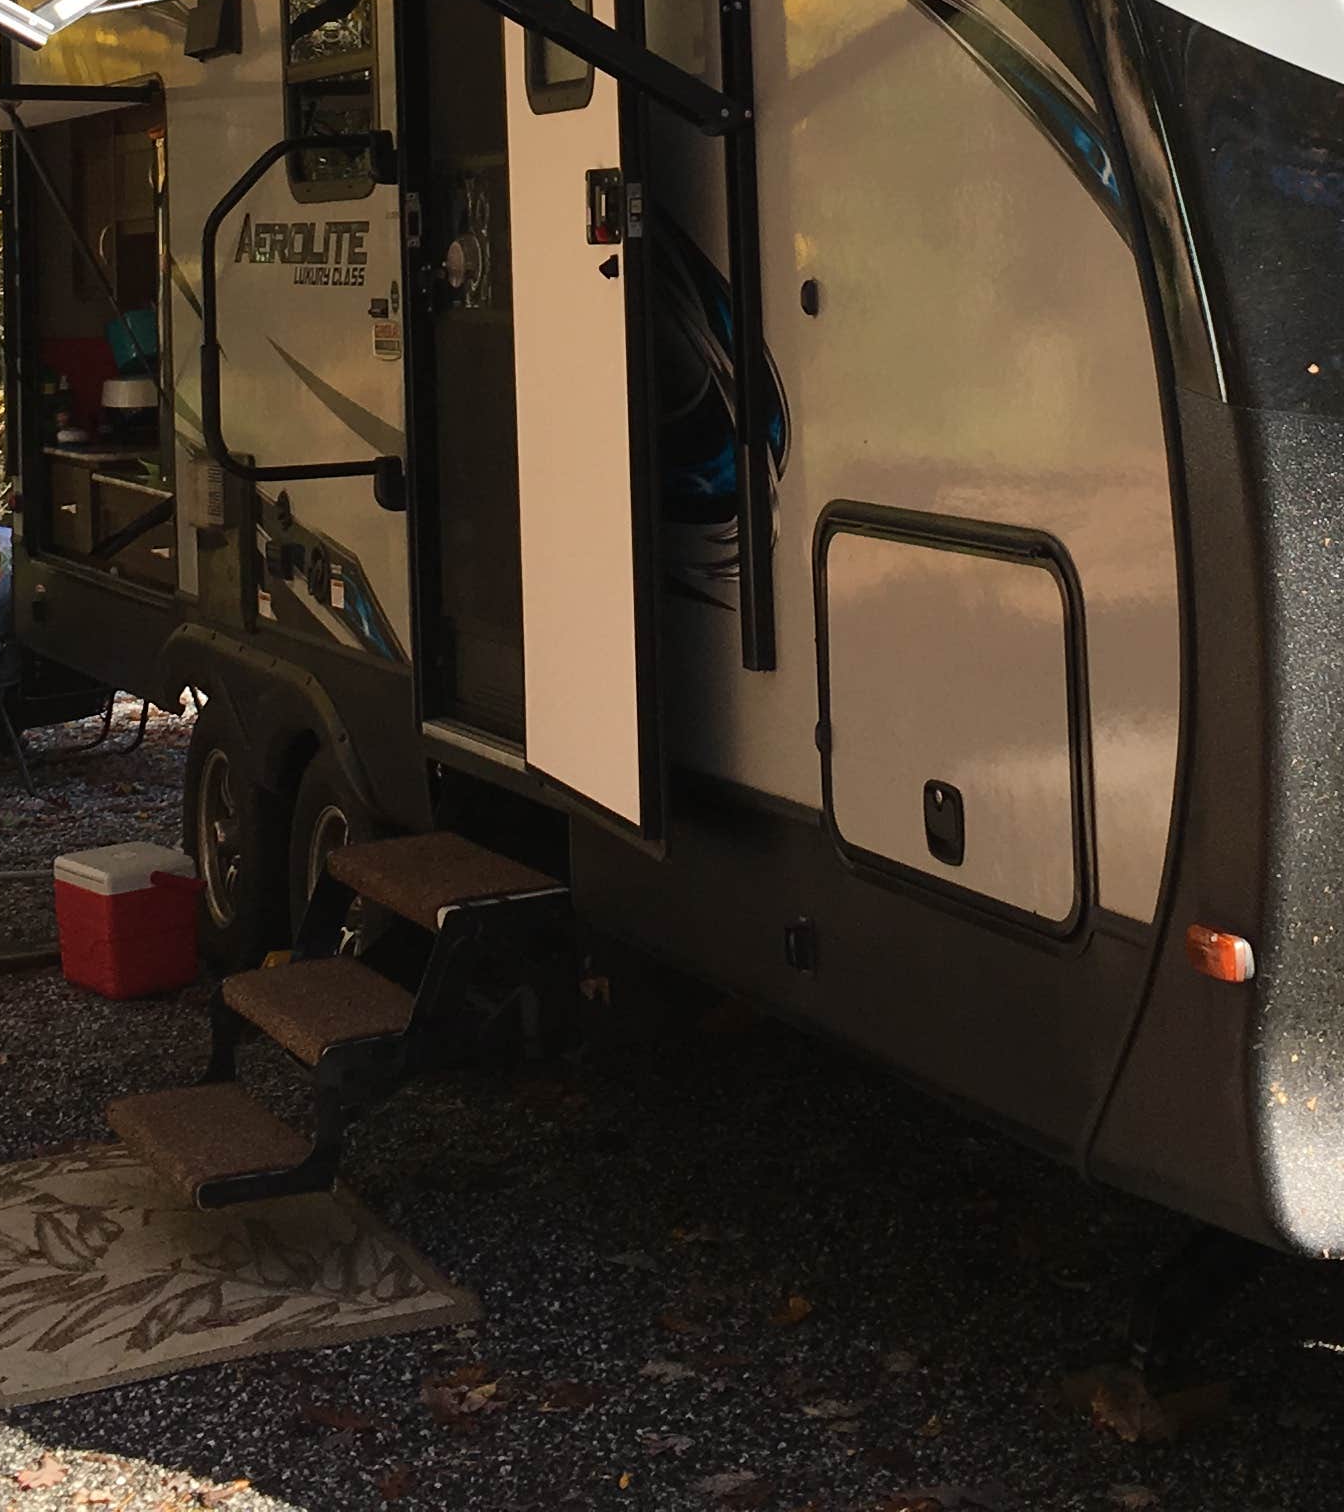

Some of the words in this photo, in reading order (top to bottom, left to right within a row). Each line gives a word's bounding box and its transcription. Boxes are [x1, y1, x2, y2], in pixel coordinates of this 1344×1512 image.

[234, 213, 370, 264] AEROLITE
[294, 266, 330, 285] LUXURY
[331, 266, 366, 286] CLASS
